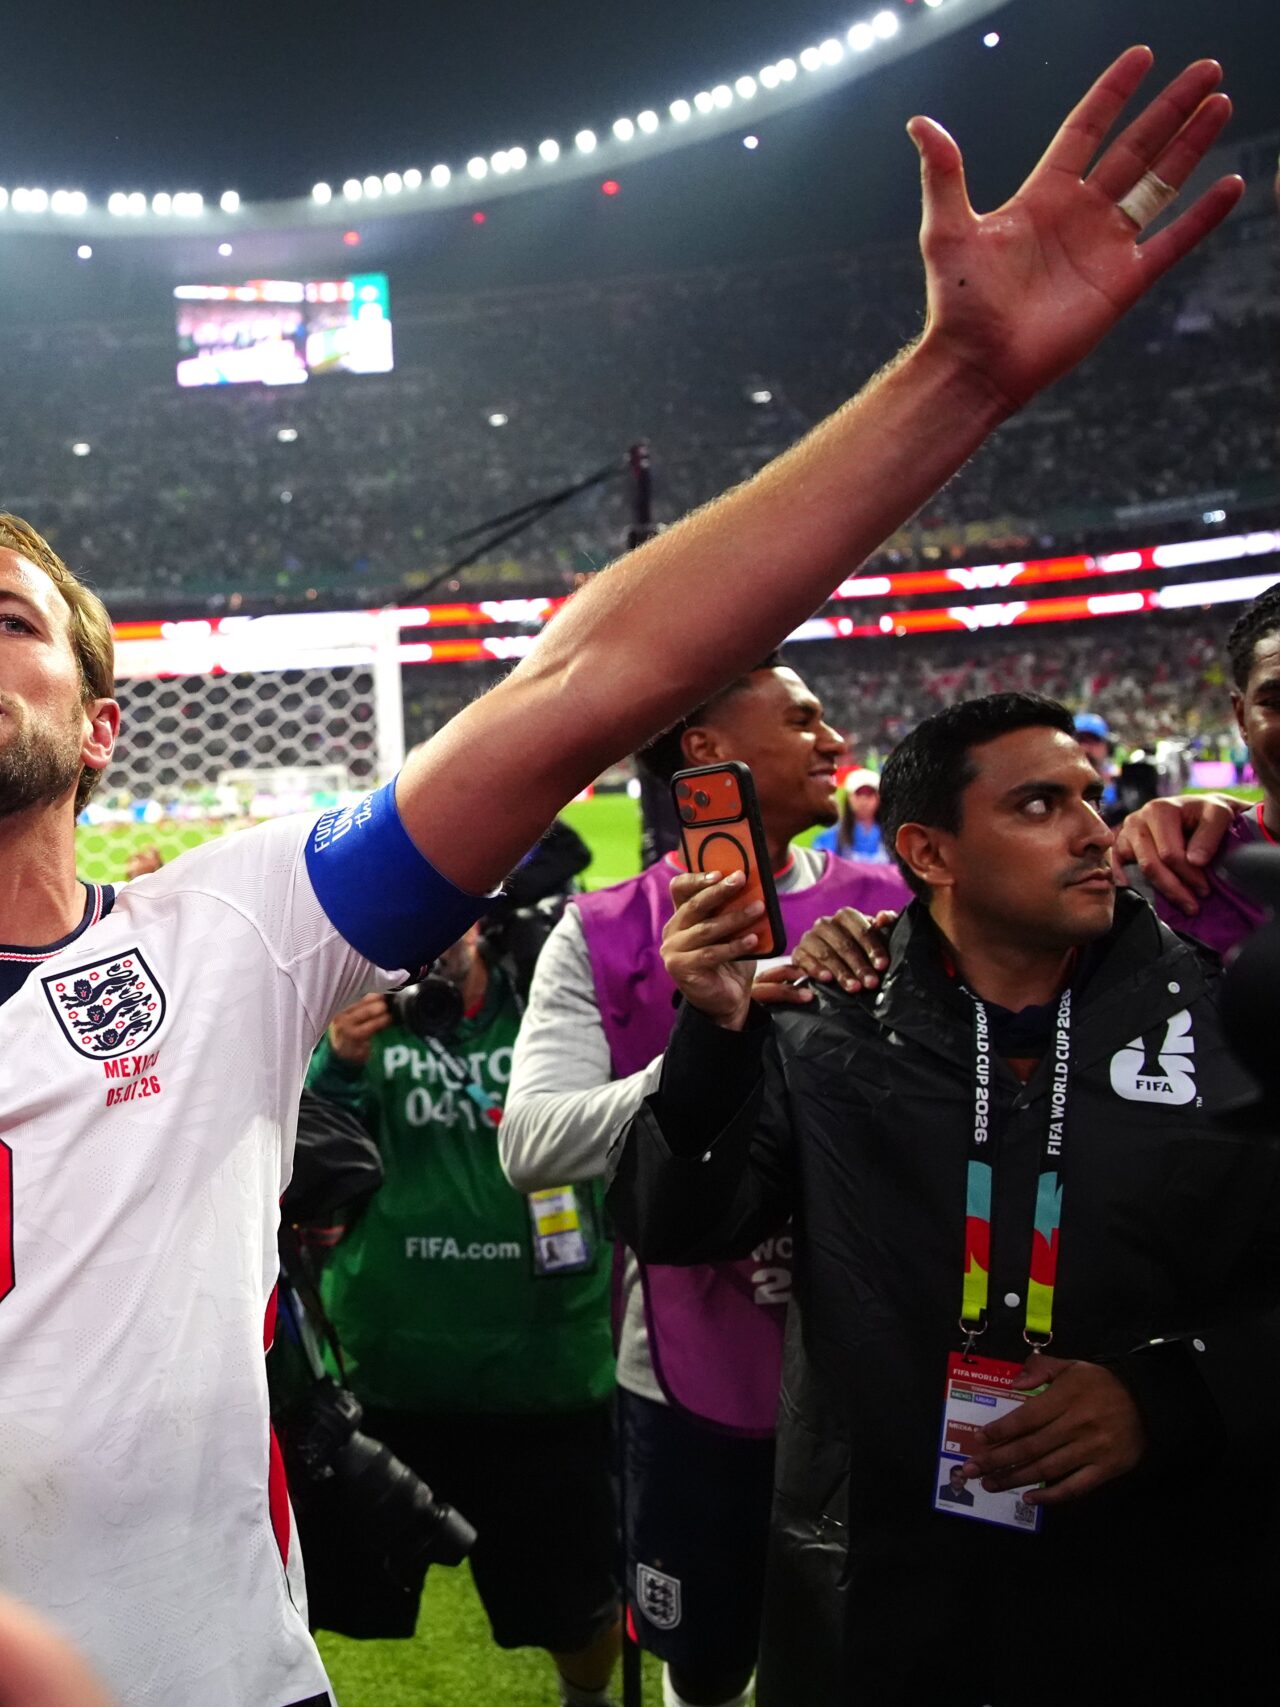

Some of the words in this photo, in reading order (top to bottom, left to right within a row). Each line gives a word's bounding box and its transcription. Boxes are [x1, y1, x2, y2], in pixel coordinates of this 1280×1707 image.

[1057, 988, 1072, 1029] 2026
[975, 1002, 989, 1052] WORLD
[1056, 1031, 1070, 1061] CUP
[976, 1056, 989, 1086] CUP
[1136, 1079, 1174, 1093] FIFA
[106, 1075, 161, 1107] 05.07.26
[1051, 1062, 1068, 1119] WORLD
[974, 1087, 989, 1143] 2026
[1047, 1122, 1064, 1155] FIFA
[405, 1236, 521, 1260] FIFA.com
[953, 1368, 970, 1377] FIFA
[970, 1371, 999, 1383] WORLD
